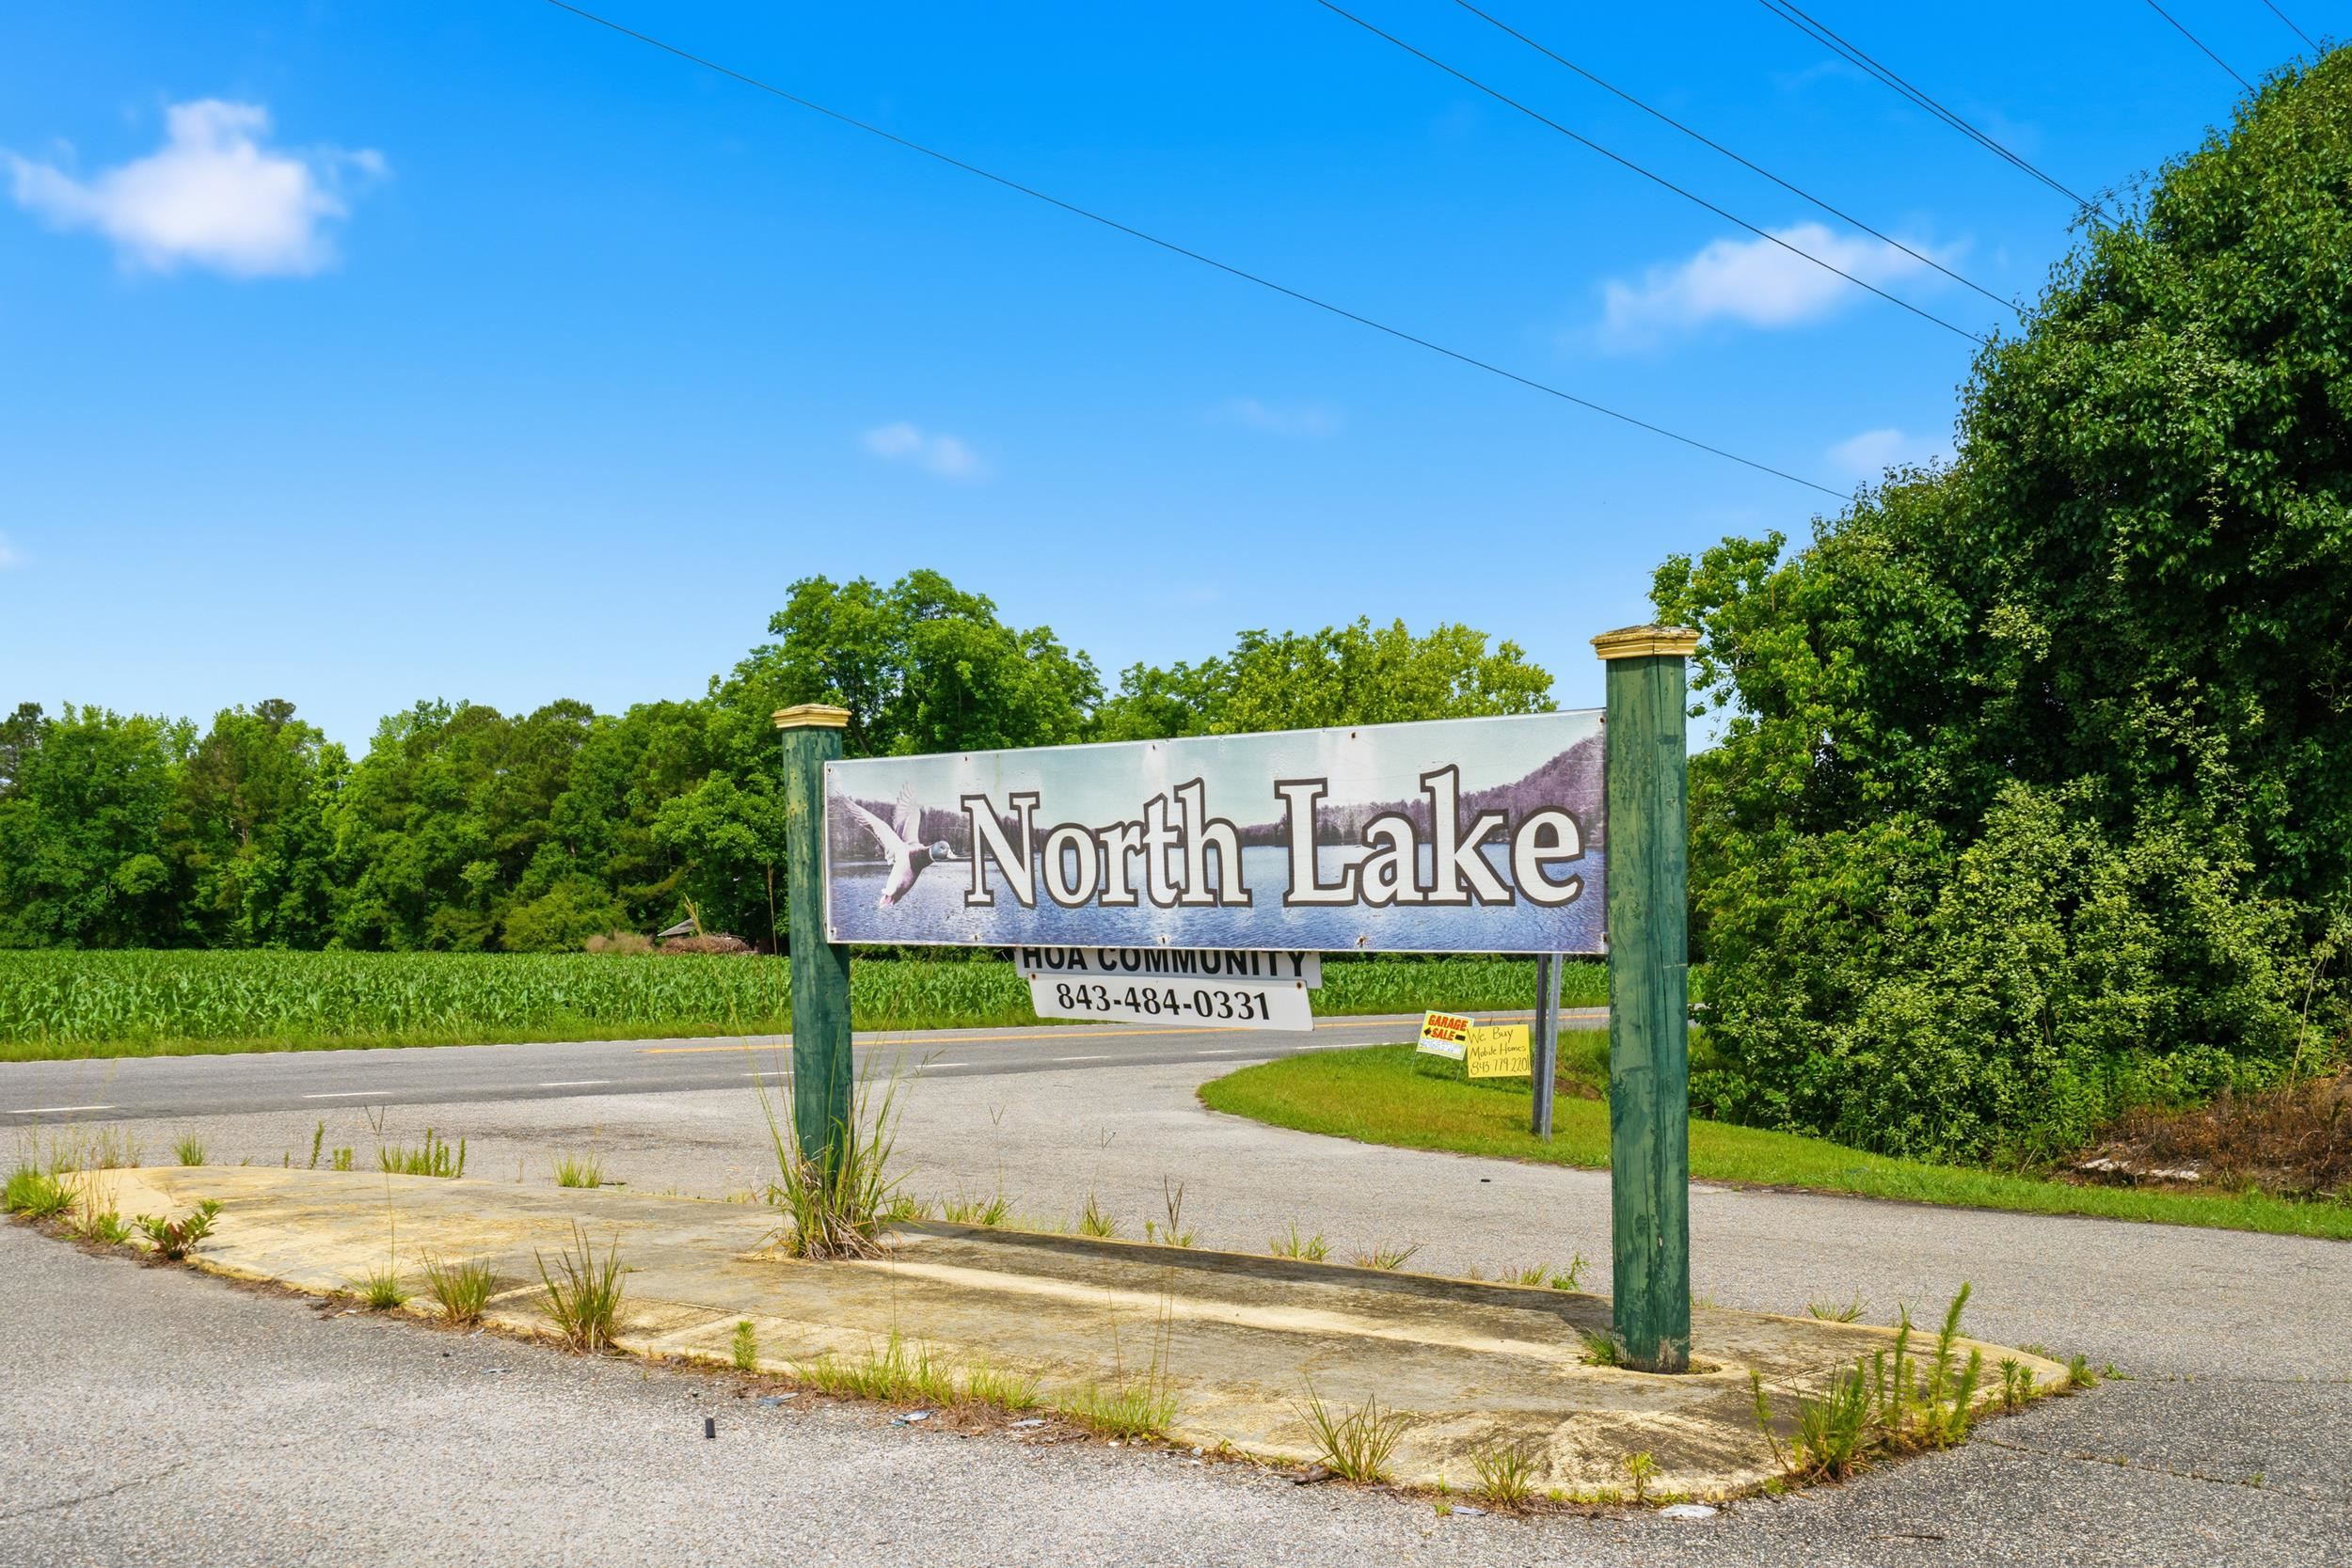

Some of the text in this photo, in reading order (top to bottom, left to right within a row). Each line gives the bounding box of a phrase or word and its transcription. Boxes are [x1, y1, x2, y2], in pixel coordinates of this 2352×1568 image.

[960, 763, 1585, 909] North Lake
[1023, 947, 1306, 977] HOA COMMUNITY
[1056, 983, 1270, 1021] 843-484-0331
[1428, 1014, 1469, 1032] GARAGE
[1430, 1027, 1456, 1041] SALE
[1466, 1026, 1513, 1044] We Buy
[1469, 1042, 1527, 1061] Mobile Homes
